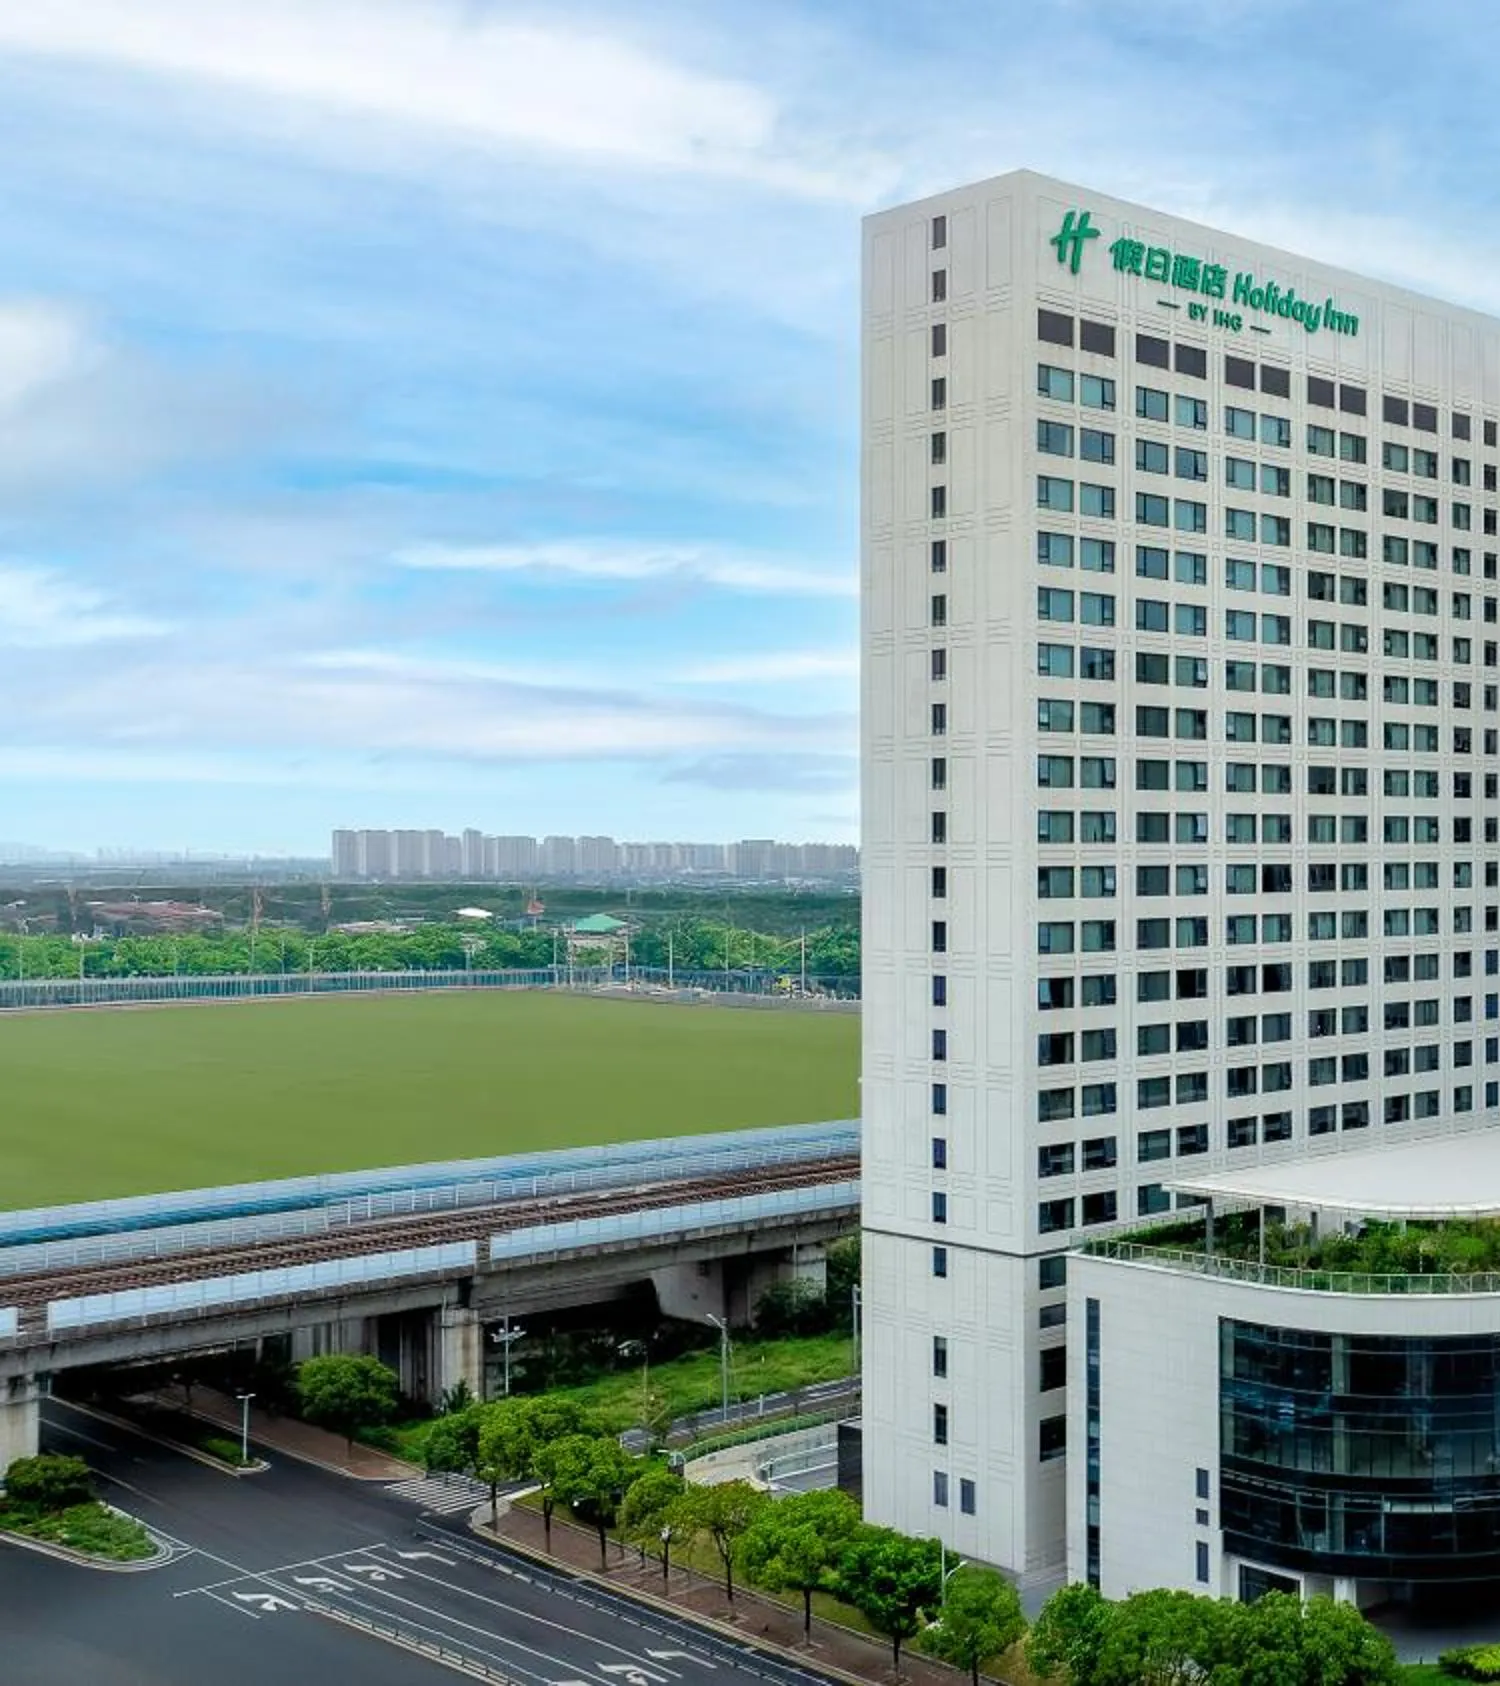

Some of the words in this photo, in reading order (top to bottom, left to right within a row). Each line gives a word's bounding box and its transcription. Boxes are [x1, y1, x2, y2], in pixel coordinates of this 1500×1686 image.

[1109, 237, 1227, 300] 假日酒店
[1188, 302, 1208, 320] BY
[1213, 309, 1243, 332] IHG
[1233, 272, 1323, 333] Holiday
[1324, 297, 1359, 336] Inn
